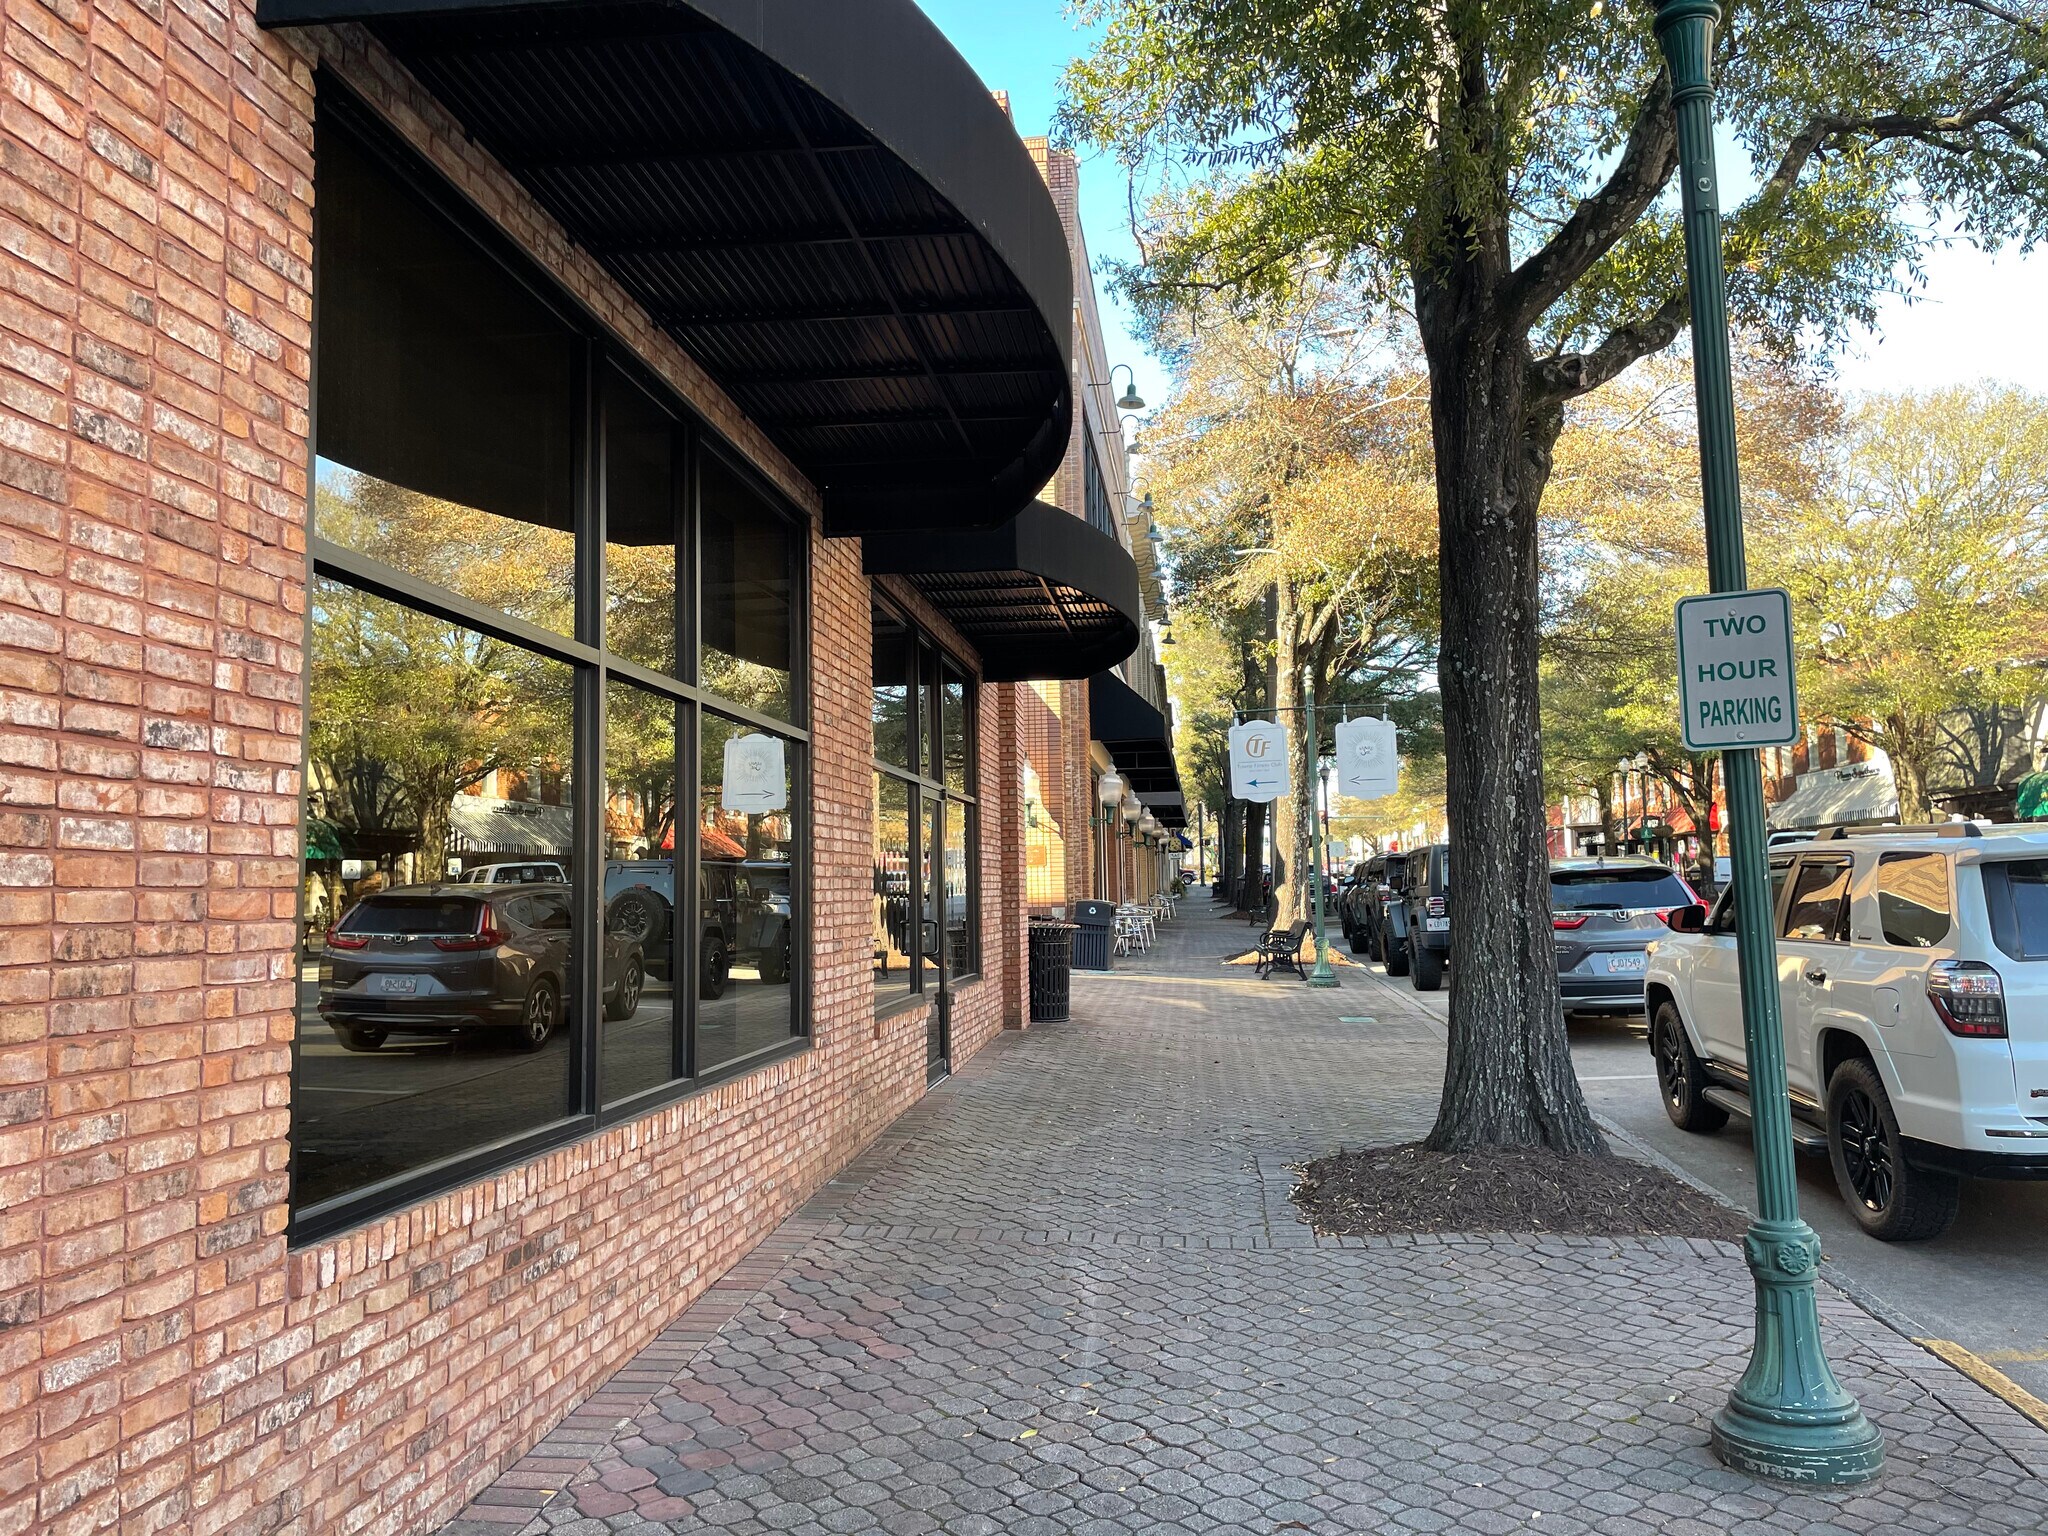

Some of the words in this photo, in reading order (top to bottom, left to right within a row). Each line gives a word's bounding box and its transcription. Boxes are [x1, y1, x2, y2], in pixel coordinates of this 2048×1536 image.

[1703, 615, 1766, 638] TWO
[1698, 658, 1777, 683] HOUR
[1700, 696, 1782, 729] PARKING
